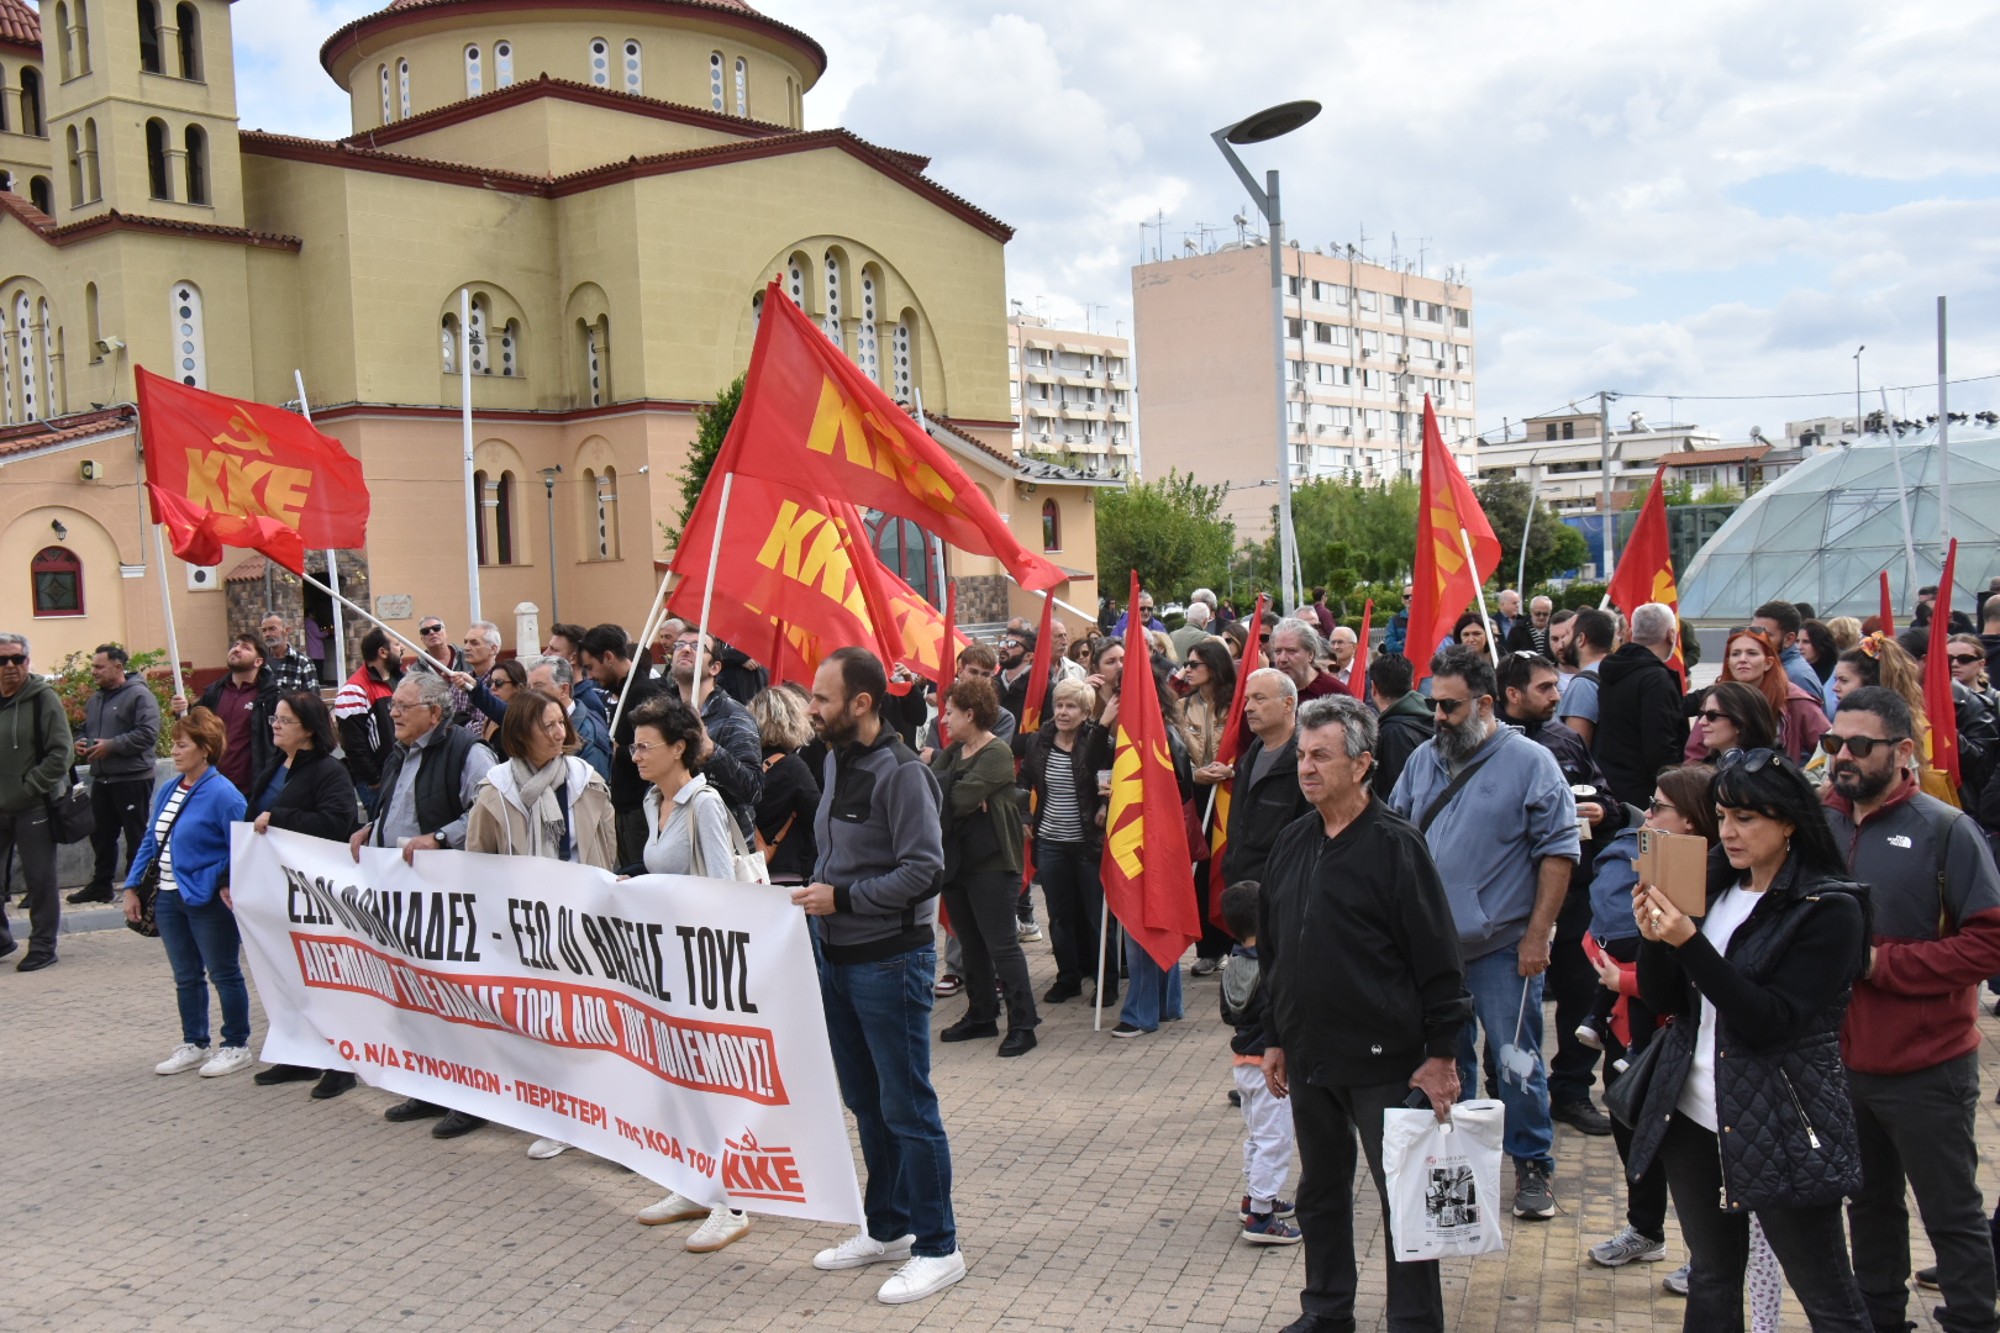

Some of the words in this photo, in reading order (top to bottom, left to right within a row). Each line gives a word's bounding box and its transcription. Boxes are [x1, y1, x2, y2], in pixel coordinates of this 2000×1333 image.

[185, 447, 312, 531] ΚΚΕ
[492, 932, 502, 940] -
[508, 898, 559, 971] ΕΞΩ
[558, 905, 594, 976] ΟΙ
[581, 912, 672, 1002] ΒΑΣΕΙΣ
[675, 925, 759, 1013] ΤΟΥΣ
[513, 986, 569, 1043] ΤΩΡΑ
[571, 994, 618, 1048] ΑΠΟ
[613, 1000, 655, 1066] ΤΟΥΣ
[650, 1016, 775, 1098] ΠΟΛΕΜΟΥΣ!
[363, 1042, 400, 1069] Ν/Δ
[402, 1049, 501, 1095] ΣΥΝΟΙΚΙΩΝ
[504, 1084, 512, 1092] -
[514, 1080, 608, 1130] ΠΕΡΙΣΤΕΡΙ
[642, 1126, 685, 1164] ΚΟΑ
[721, 1149, 805, 1193] ΚΚΕ
